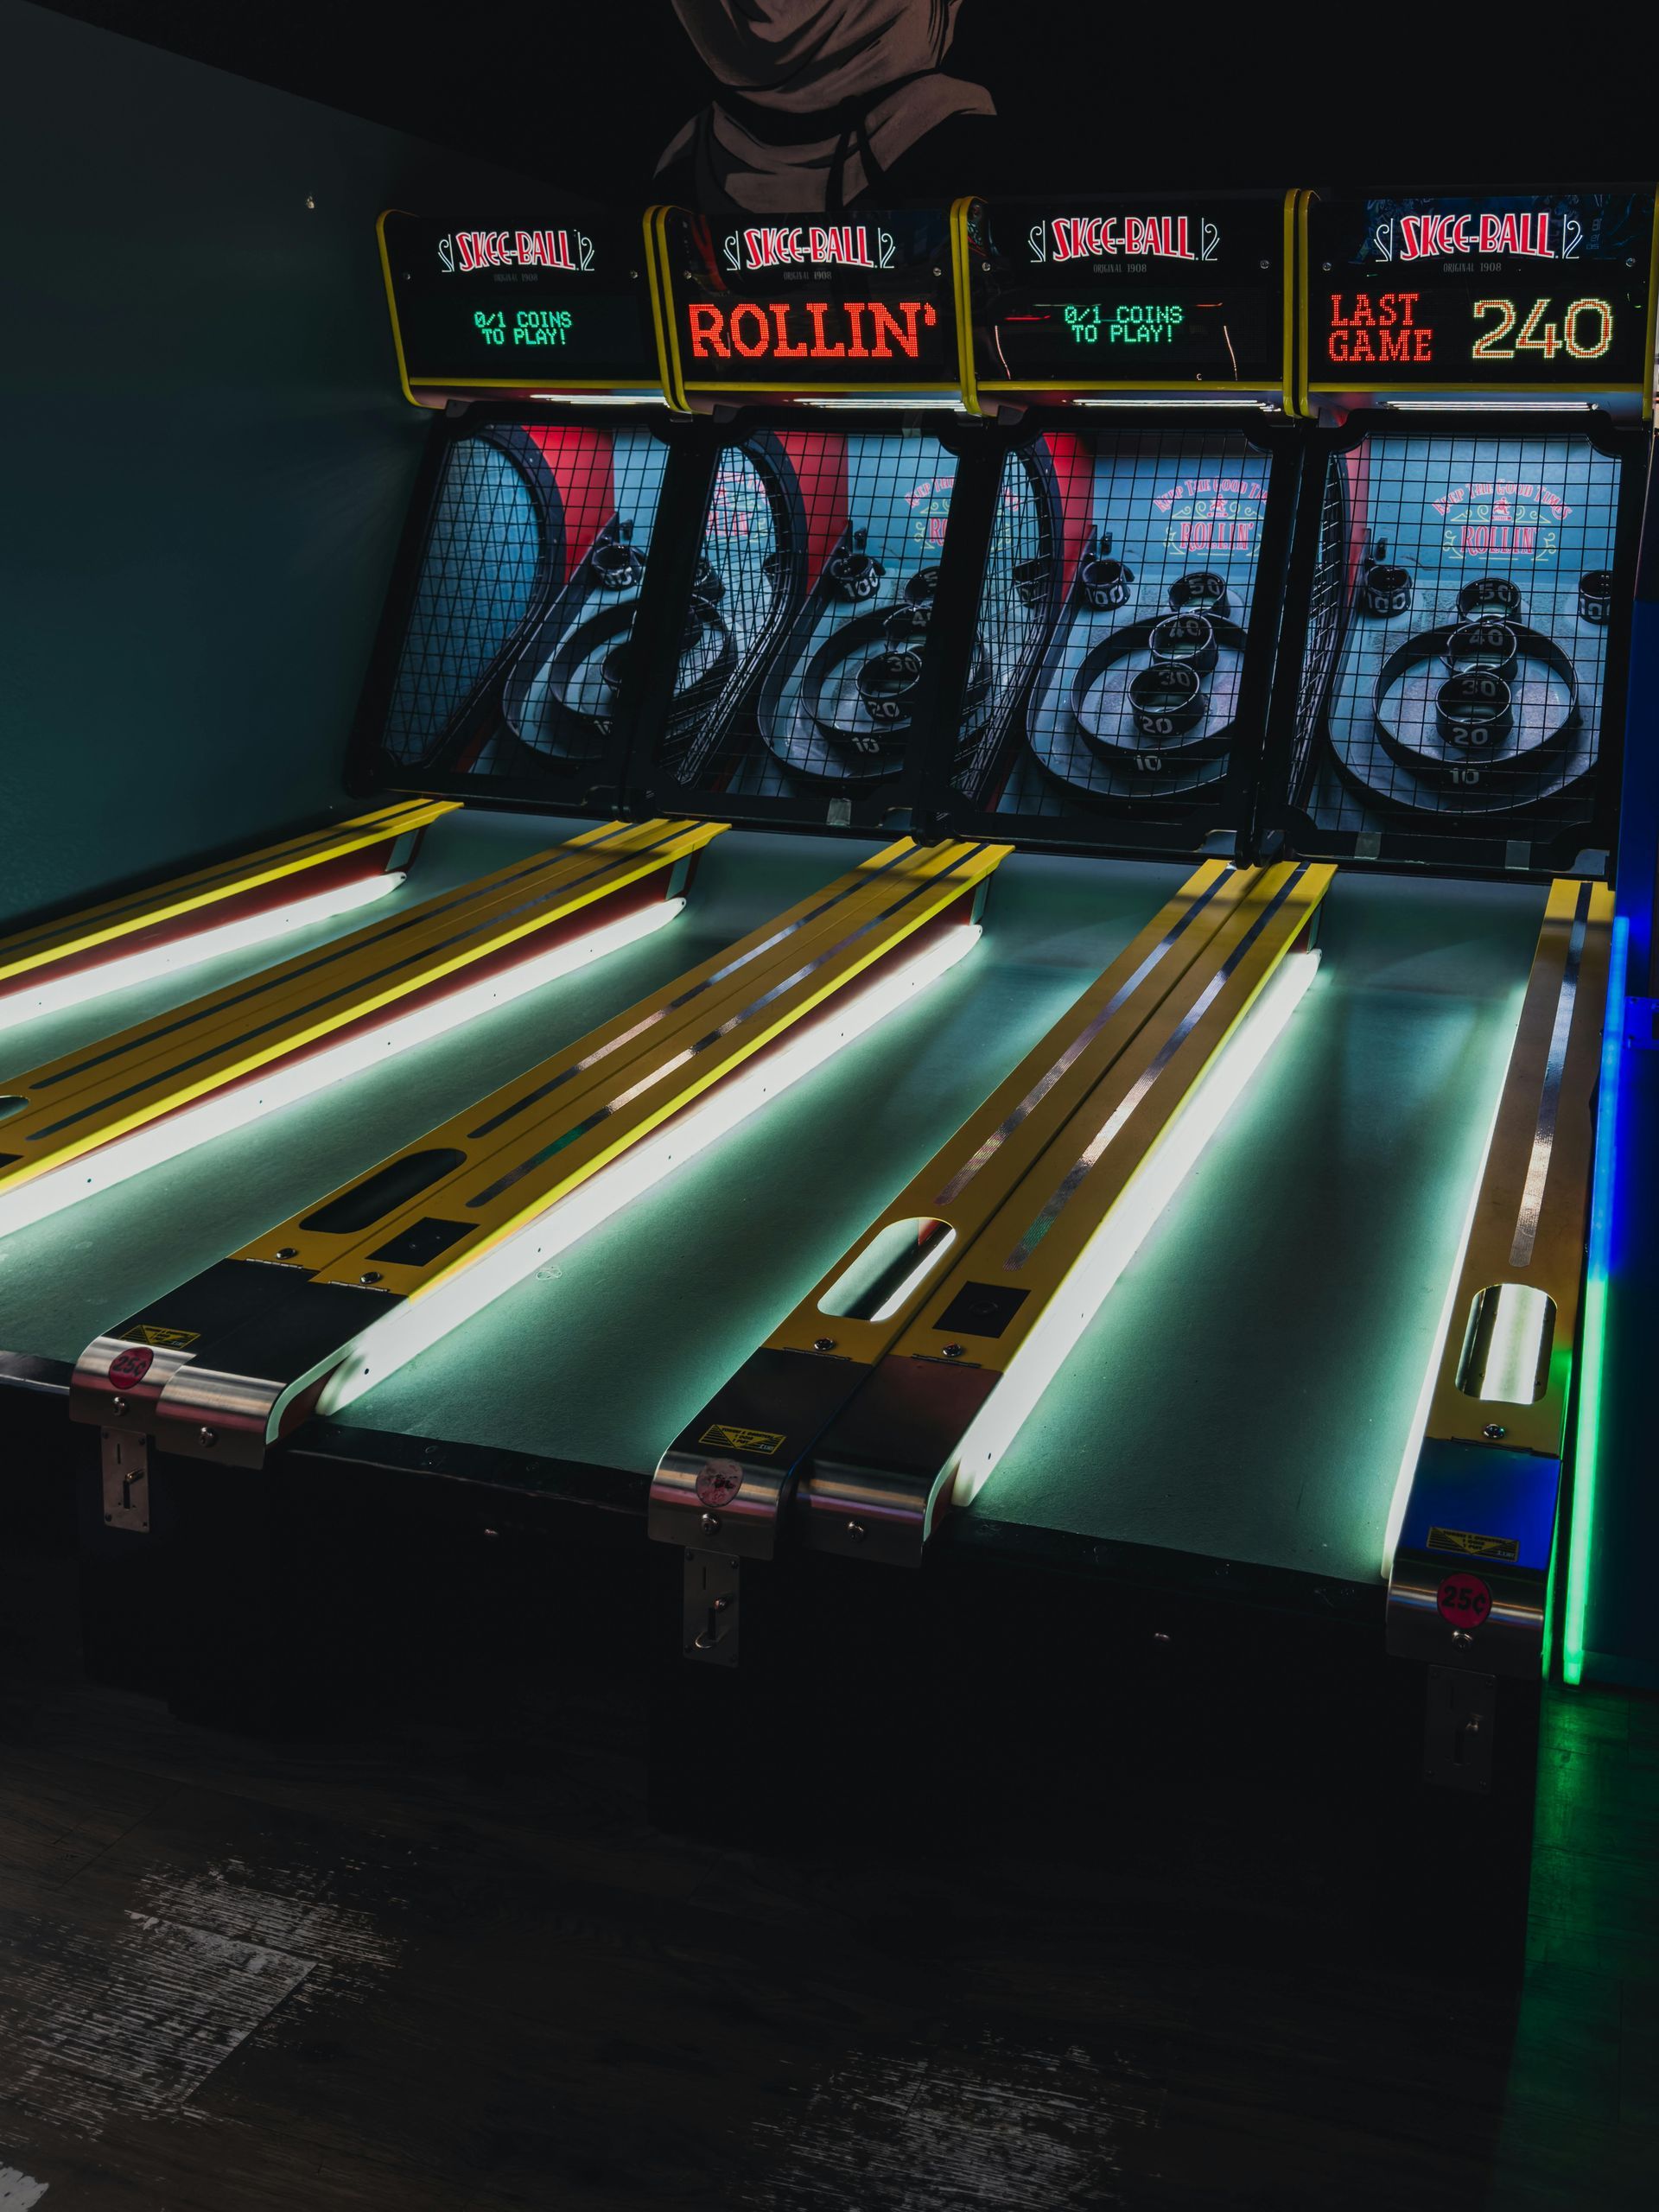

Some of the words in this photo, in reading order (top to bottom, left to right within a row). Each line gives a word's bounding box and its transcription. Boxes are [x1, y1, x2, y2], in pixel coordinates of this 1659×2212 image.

[1051, 216, 1196, 262] SKEE-BALL
[1400, 213, 1554, 260] SKEE-BALL
[455, 229, 577, 272] SKEE-BALL
[743, 226, 875, 270] SKEE-BALL
[784, 271, 810, 281] ORIGINAL
[813, 270, 832, 280] 1908
[1093, 264, 1122, 274] ORIGINAL
[1127, 264, 1147, 273] 1908
[1443, 263, 1474, 273] ORIGINAL
[1480, 262, 1502, 272] 1908
[521, 273, 538, 283] 1908
[1065, 305, 1102, 324] 0/1
[1116, 305, 1184, 324] COINS
[1329, 293, 1420, 327] LAST
[474, 311, 506, 328] 0/1
[517, 311, 573, 328] COINS
[482, 328, 505, 346] TO
[513, 328, 567, 346] PLAY!
[689, 302, 937, 359] ROLLIN'
[1071, 325, 1098, 343] TO
[1109, 325, 1174, 343] PLAY!
[1472, 299, 1613, 359] 240
[1327, 329, 1433, 362] GAME
[1432, 488, 1465, 516] KEEP
[1465, 482, 1494, 499] THE
[1495, 479, 1534, 498] GOOD
[1534, 486, 1573, 520] TIMES
[844, 567, 878, 597] 100
[1189, 577, 1221, 595] 50
[1478, 582, 1511, 602] 50
[1169, 620, 1201, 638] 40
[1469, 628, 1503, 647] 40
[890, 657, 918, 672] 30
[1159, 670, 1191, 687] 30
[1461, 680, 1497, 697] 30
[868, 701, 900, 718] 20
[1141, 715, 1173, 734] 20
[852, 737, 880, 753] 10
[1452, 728, 1489, 745] 20
[1135, 754, 1161, 772] 10
[1449, 767, 1479, 785] 10
[1442, 1586, 1485, 1615] 25¢
